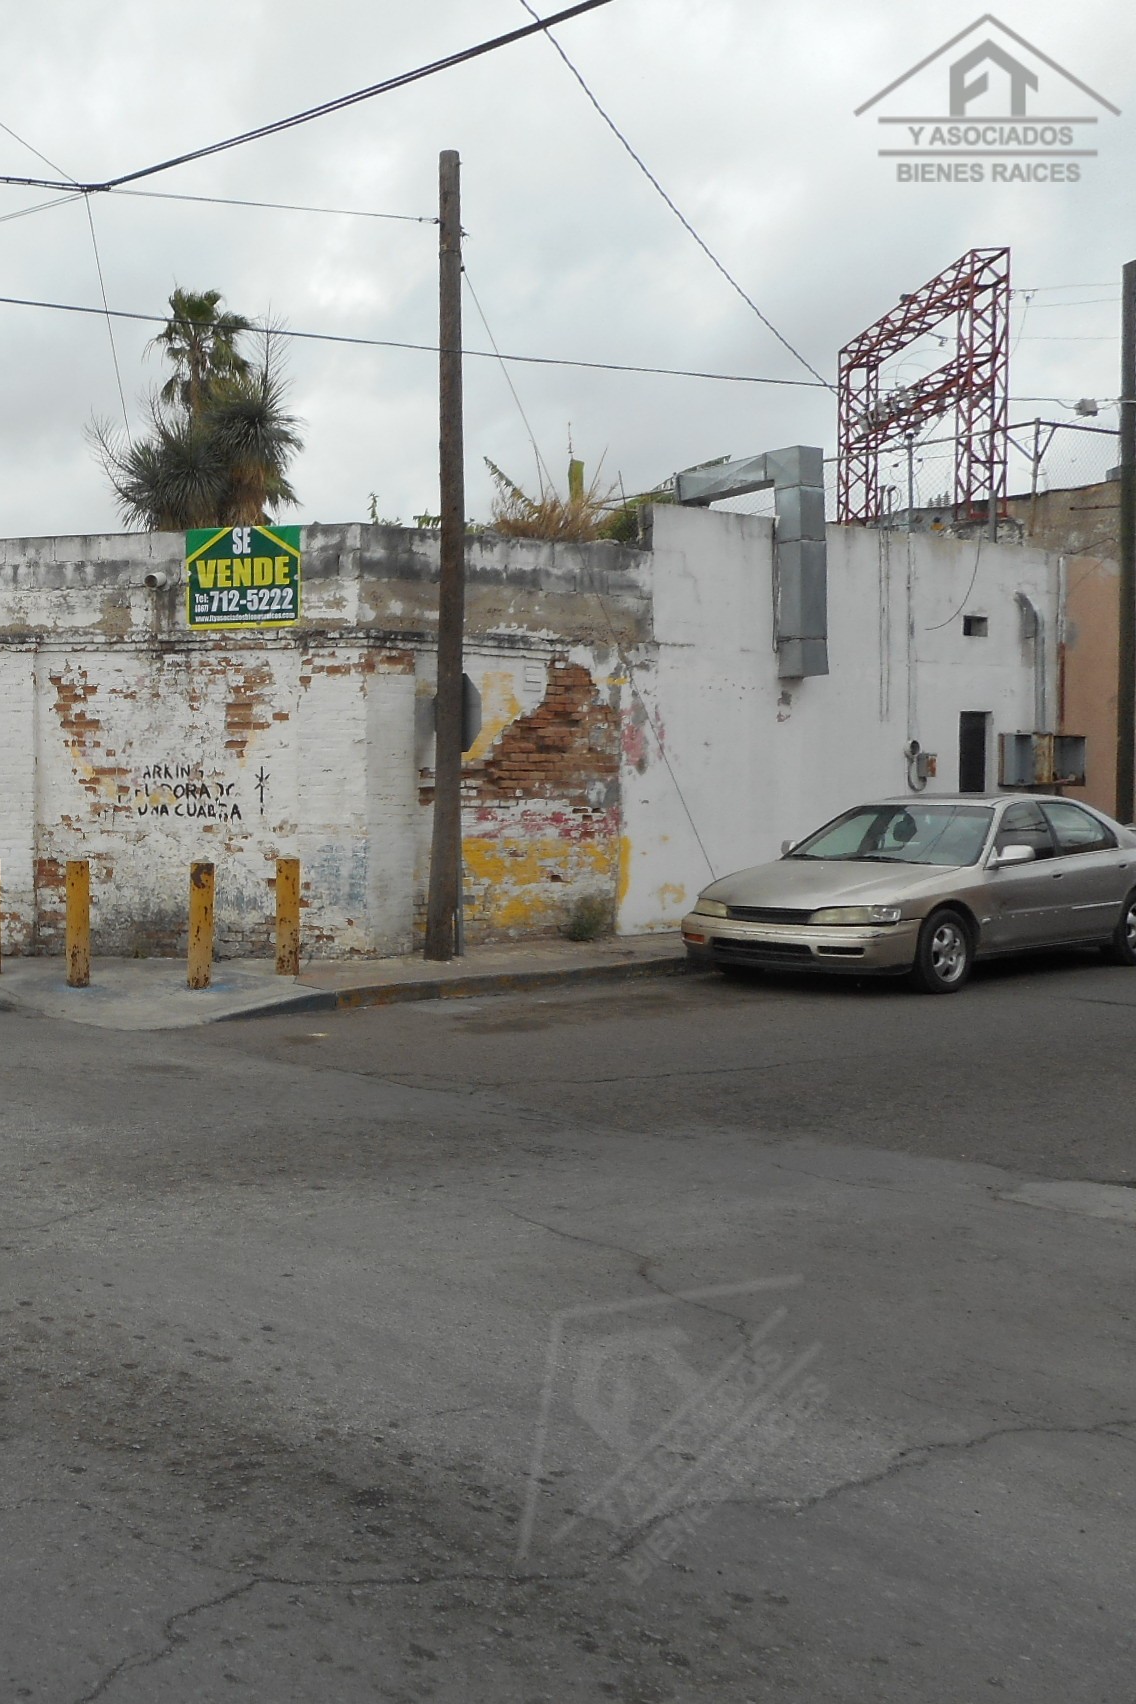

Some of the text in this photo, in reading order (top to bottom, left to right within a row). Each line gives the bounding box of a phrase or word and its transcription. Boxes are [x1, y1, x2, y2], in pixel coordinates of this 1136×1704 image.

[232, 527, 251, 554] SE
[196, 556, 290, 588] VENDE
[195, 588, 294, 612] Tel: 712-5222
